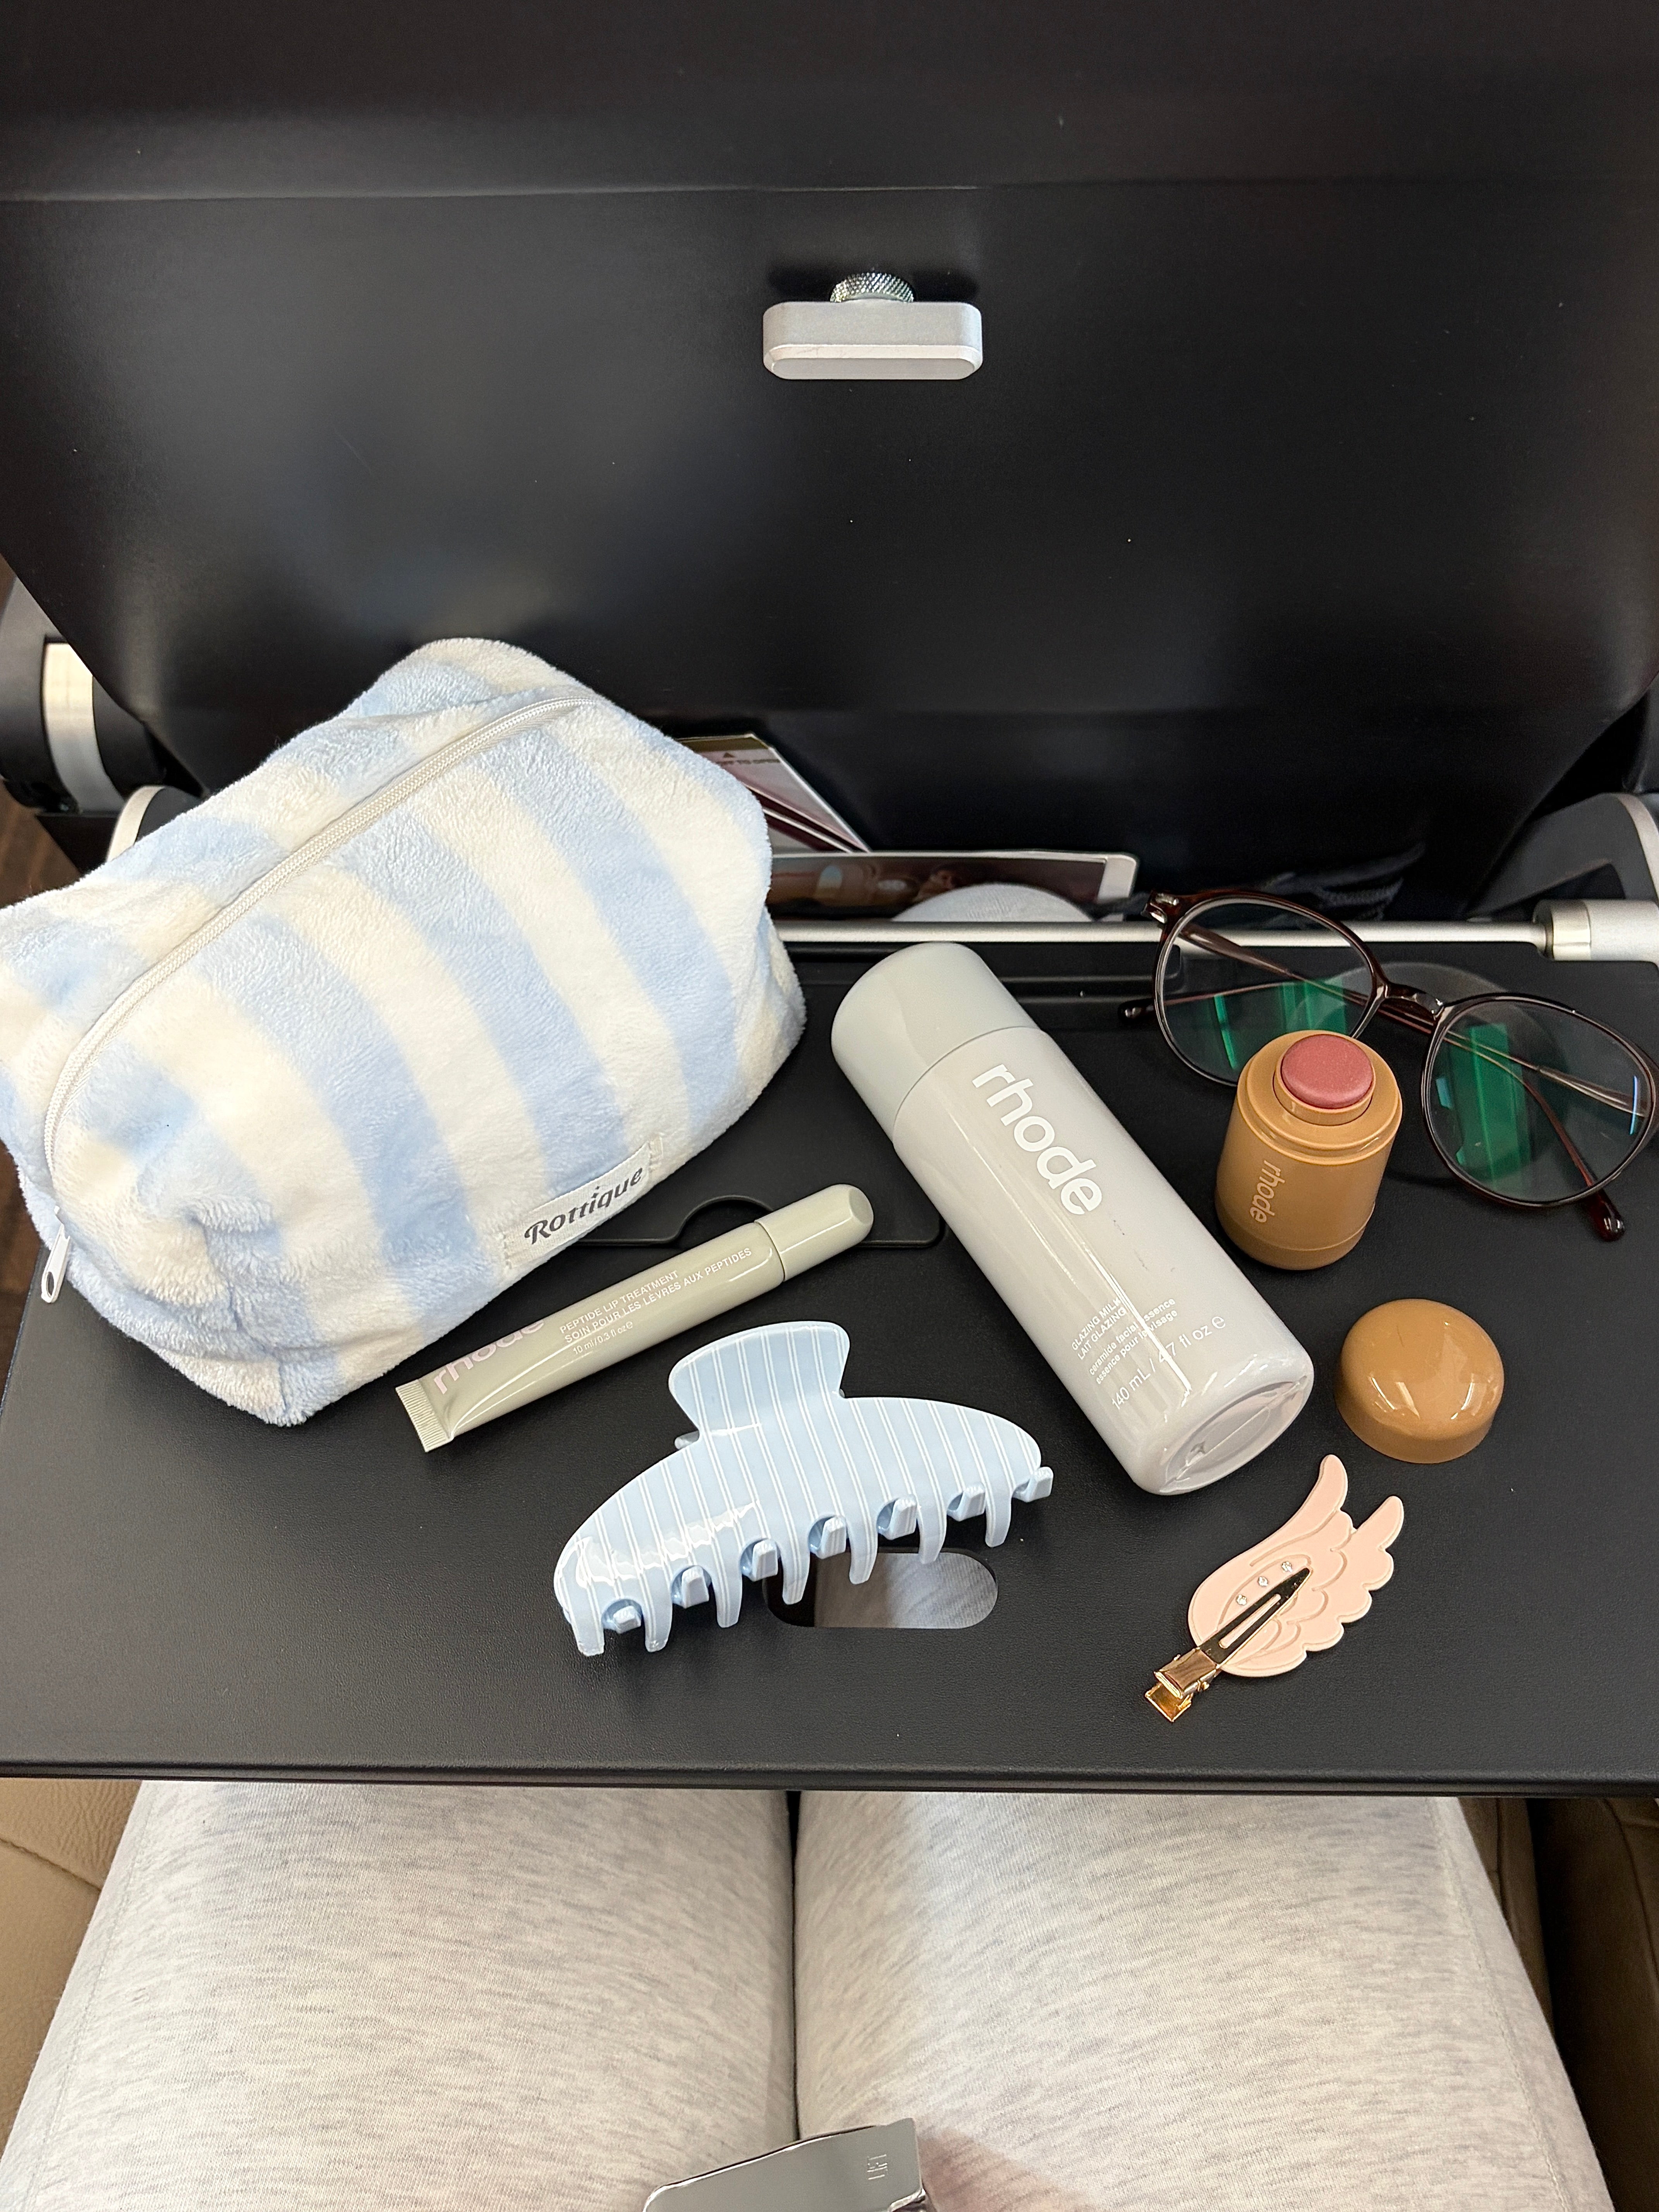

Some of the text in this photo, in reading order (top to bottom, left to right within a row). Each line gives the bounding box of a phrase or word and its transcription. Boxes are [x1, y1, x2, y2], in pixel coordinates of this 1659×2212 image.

[972, 1064, 1102, 1215] rhode
[524, 1167, 642, 1245] Rottique
[1250, 1160, 1285, 1223] rhode
[560, 1270, 678, 1333] PEPTIDE LIP TREATMENT
[565, 1247, 752, 1343] SOIN POUR LES LÈVRES AUX PEPTIDES
[1072, 1297, 1121, 1350] GLAZING MILK
[573, 1345, 583, 1354] 10
[1077, 1307, 1127, 1360] LAIT GLAZING
[1089, 1298, 1176, 1375] ceramide facial ssence
[1096, 1354, 1121, 1384] essence
[1120, 1336, 1139, 1358] pour
[1149, 1310, 1178, 1331] visage
[1112, 1387, 1130, 1410] 140
[1128, 1368, 1151, 1391] mL
[1149, 1358, 1156, 1372] /
[1159, 1341, 1176, 1363] 47
[1178, 1334, 1192, 1348] fl
[1192, 1325, 1212, 1340] oz
